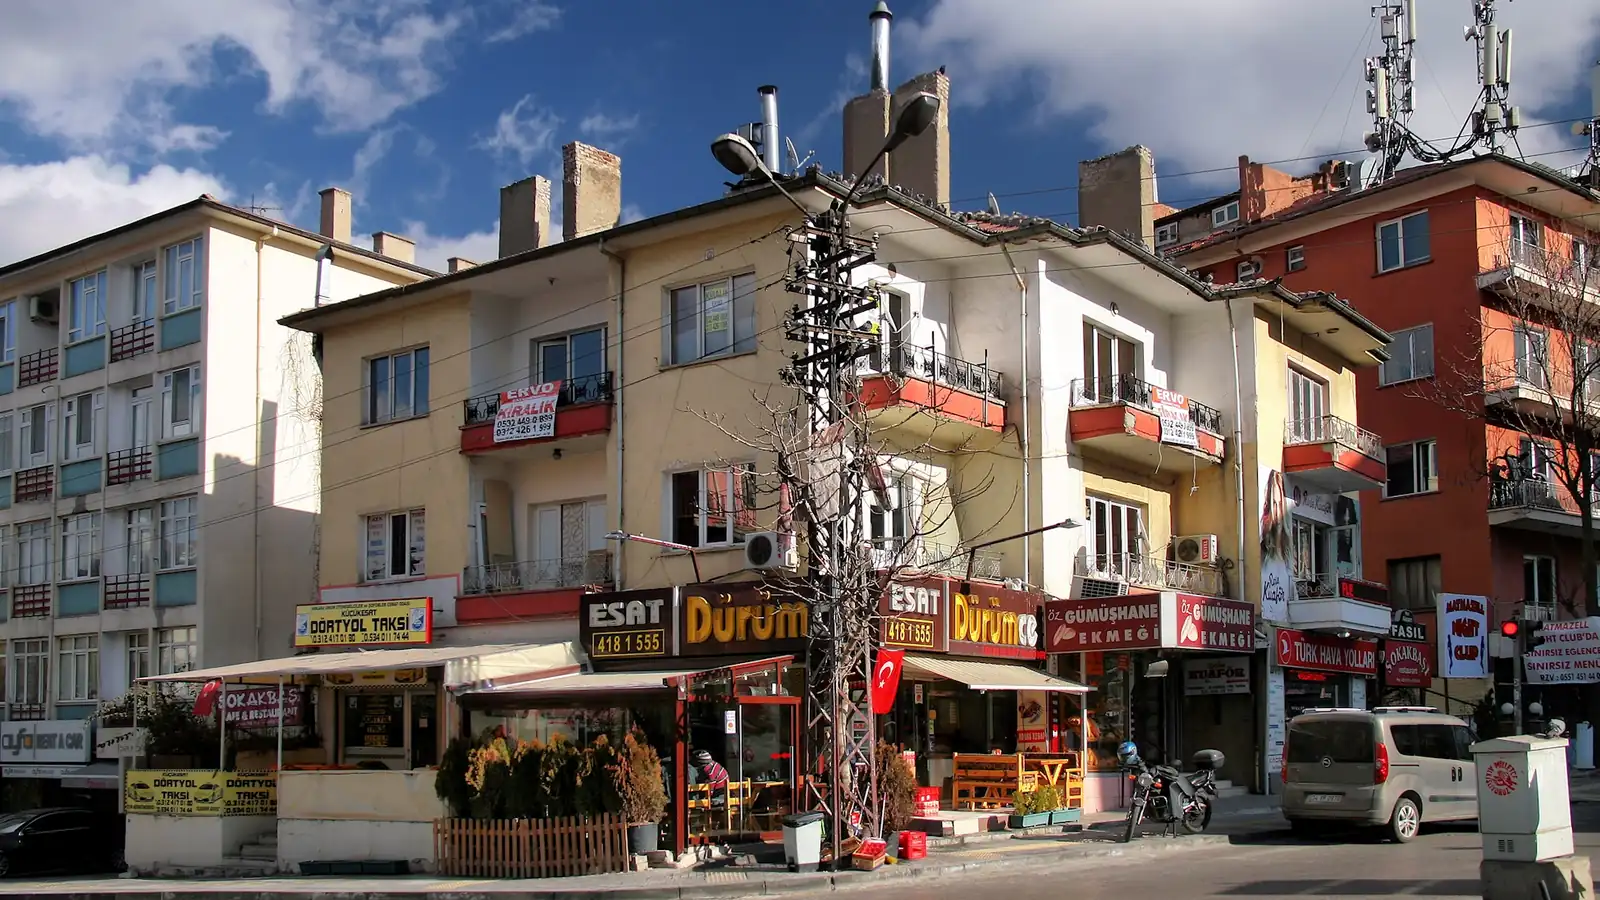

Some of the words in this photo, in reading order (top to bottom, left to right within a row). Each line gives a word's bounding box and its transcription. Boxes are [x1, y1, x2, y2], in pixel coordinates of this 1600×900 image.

[507, 383, 554, 400] ERVO
[1157, 387, 1185, 405] ERVO
[589, 599, 665, 628] ESAT
[687, 590, 828, 643] Dürüm
[890, 582, 941, 615] ESAT
[953, 592, 1038, 648] Dürümce
[1065, 603, 1159, 626] GÜMÜŞHANE
[1193, 600, 1251, 629] GÜMÜŞHANE
[310, 617, 367, 634] DÖRTYOL
[372, 613, 409, 631] TAKSİ
[889, 621, 905, 641] 418
[915, 623, 931, 643] 555
[1391, 624, 1424, 640] FASIL
[1541, 621, 1589, 631] ATMAZELL
[598, 636, 620, 653] 418
[625, 635, 631, 652] 1
[636, 633, 659, 651] 555
[1079, 624, 1159, 645] EKMEĞİ
[1201, 631, 1251, 648] EKMEĞİ
[1559, 632, 1599, 643] CLUB'DA
[1294, 638, 1318, 664] TÜRK
[1320, 645, 1342, 666] HAVA
[1343, 650, 1376, 670] YOLLARI
[1527, 660, 1571, 671] SINIRSIZ
[226, 710, 241, 722] AFE
[153, 777, 197, 788] DÖRTYOL
[161, 790, 190, 800] TAKSİ
[235, 789, 270, 800] TAKSİ
